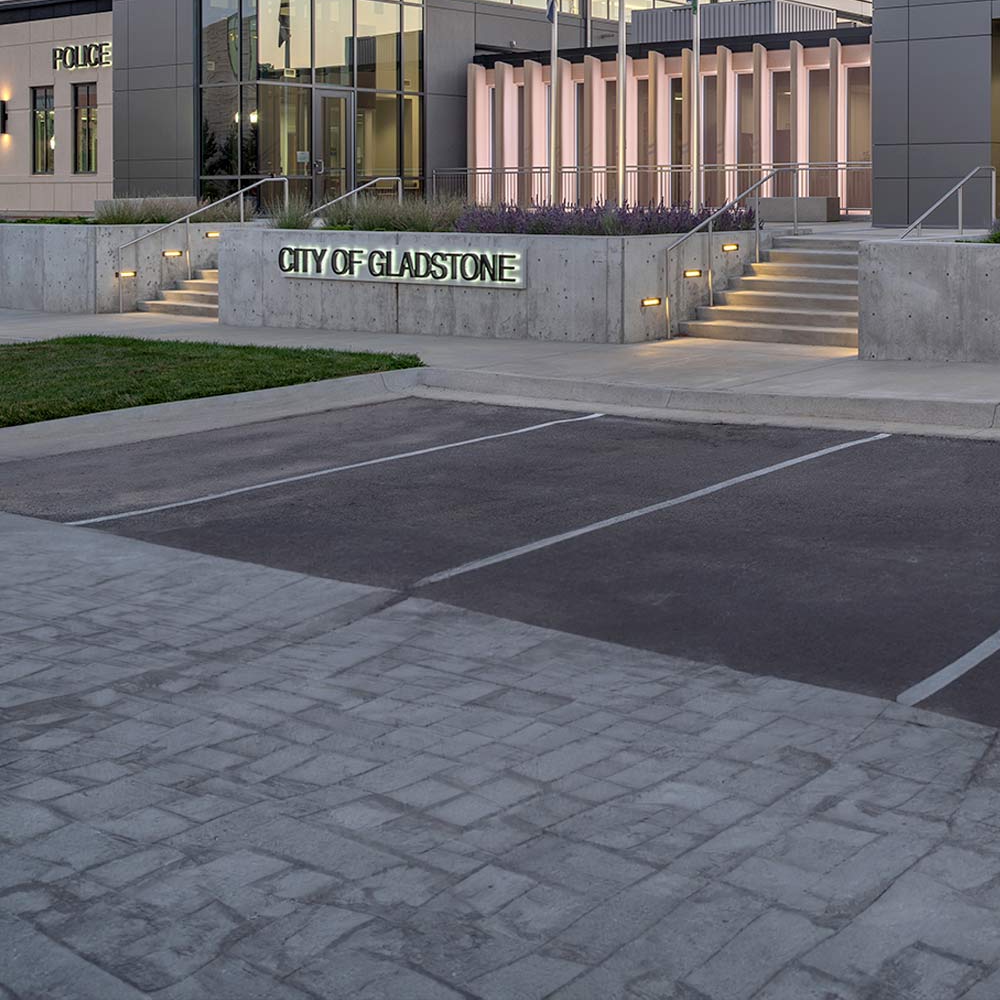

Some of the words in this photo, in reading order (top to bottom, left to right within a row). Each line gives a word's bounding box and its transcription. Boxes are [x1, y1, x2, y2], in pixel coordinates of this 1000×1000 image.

[52, 41, 112, 71] POLICE
[278, 246, 328, 275] CITY
[331, 248, 364, 276] OF
[367, 250, 518, 283] GLADSTONE
